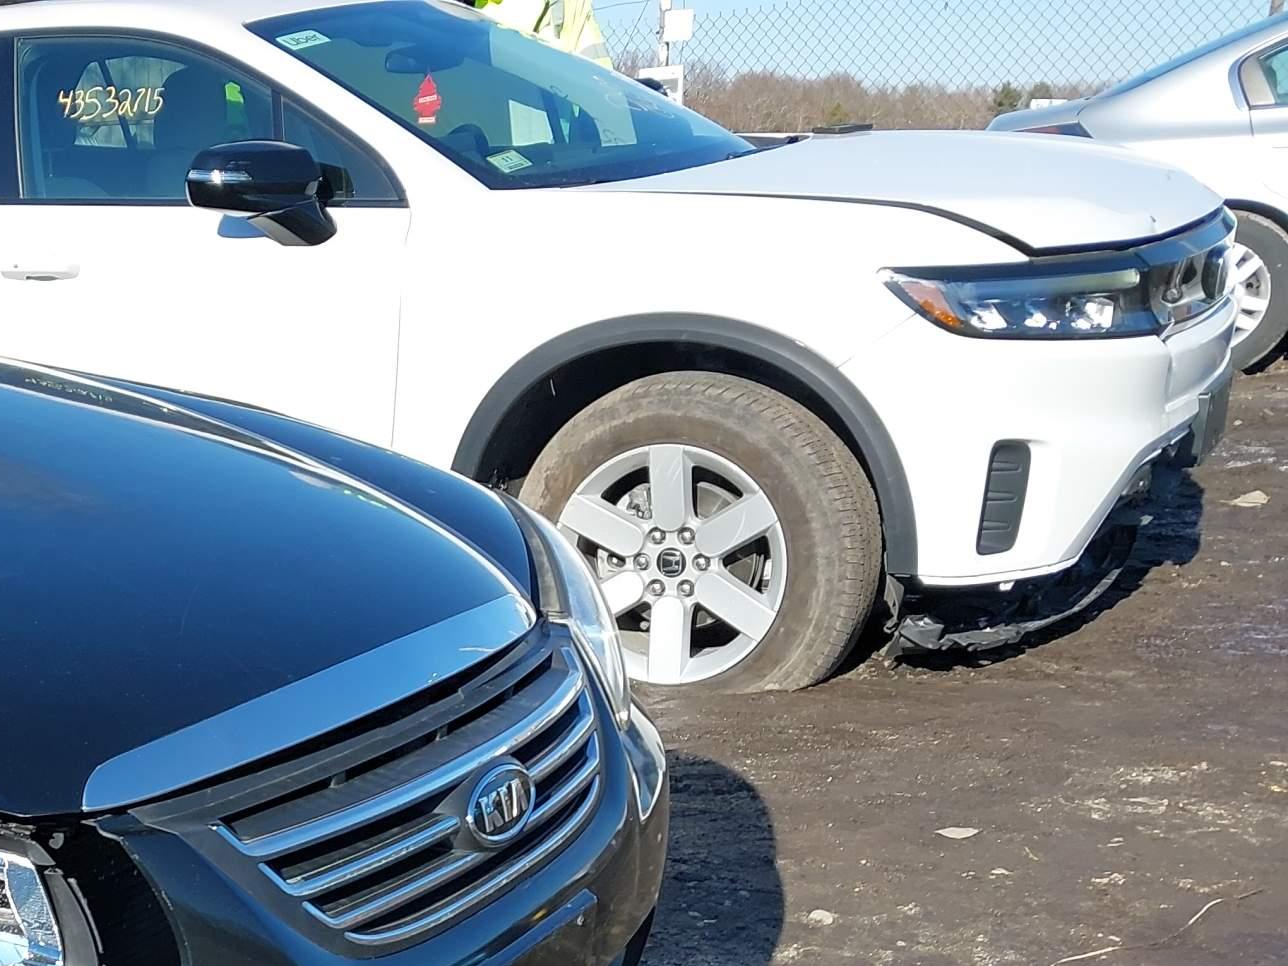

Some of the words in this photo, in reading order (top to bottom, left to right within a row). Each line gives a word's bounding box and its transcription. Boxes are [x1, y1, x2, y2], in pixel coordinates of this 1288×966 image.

[282, 33, 321, 46] Uber
[58, 86, 165, 120] 43532715
[478, 778, 529, 833] KIA
